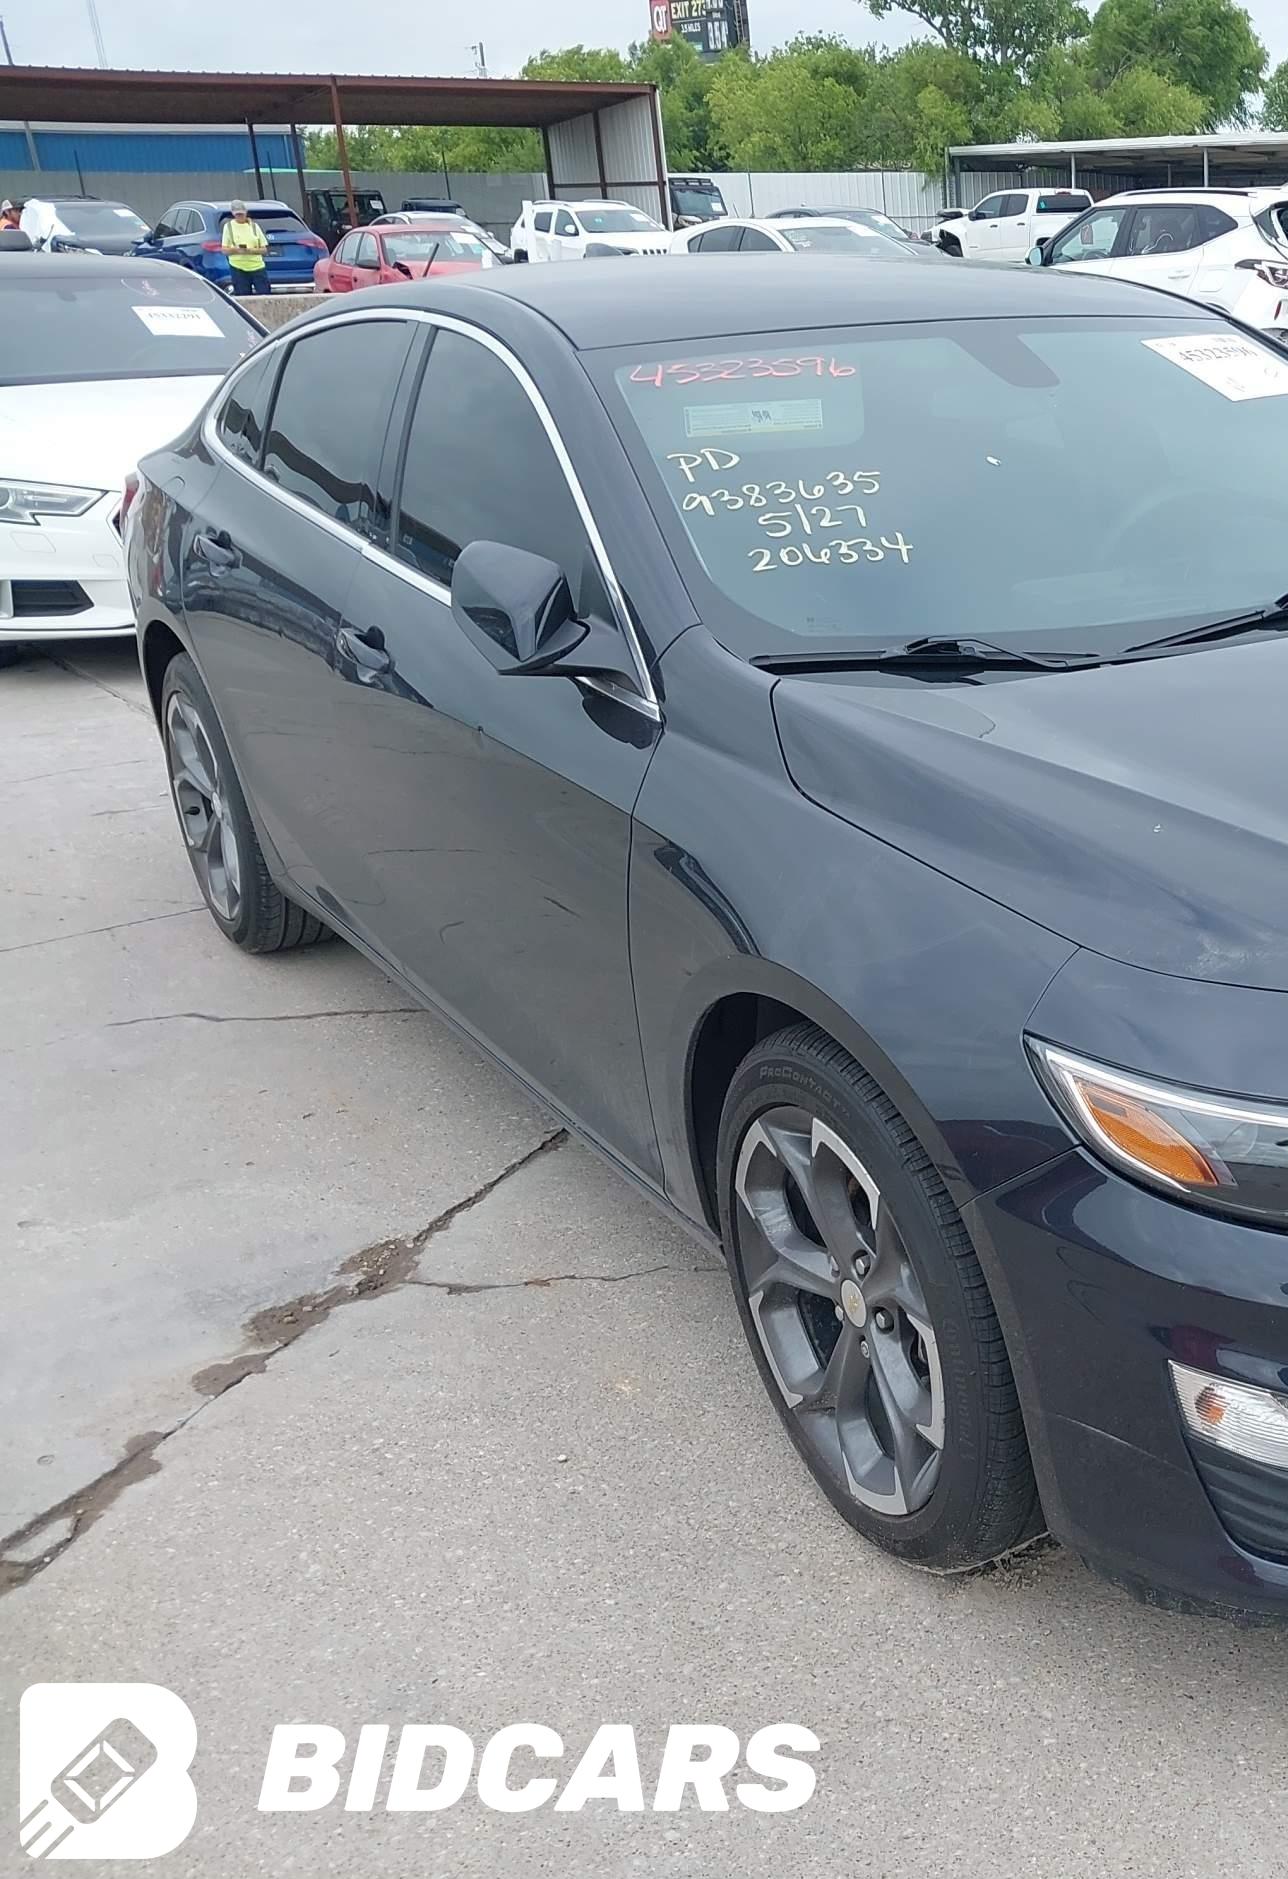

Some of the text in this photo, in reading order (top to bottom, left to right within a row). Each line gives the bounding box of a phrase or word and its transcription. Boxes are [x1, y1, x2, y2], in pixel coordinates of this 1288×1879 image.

[653, 5, 667, 34] QT
[671, 2, 689, 19] EXIT
[629, 356, 857, 387] 45323596
[667, 448, 741, 482] PD
[682, 471, 881, 516] 9383635
[747, 531, 914, 572] 206334
